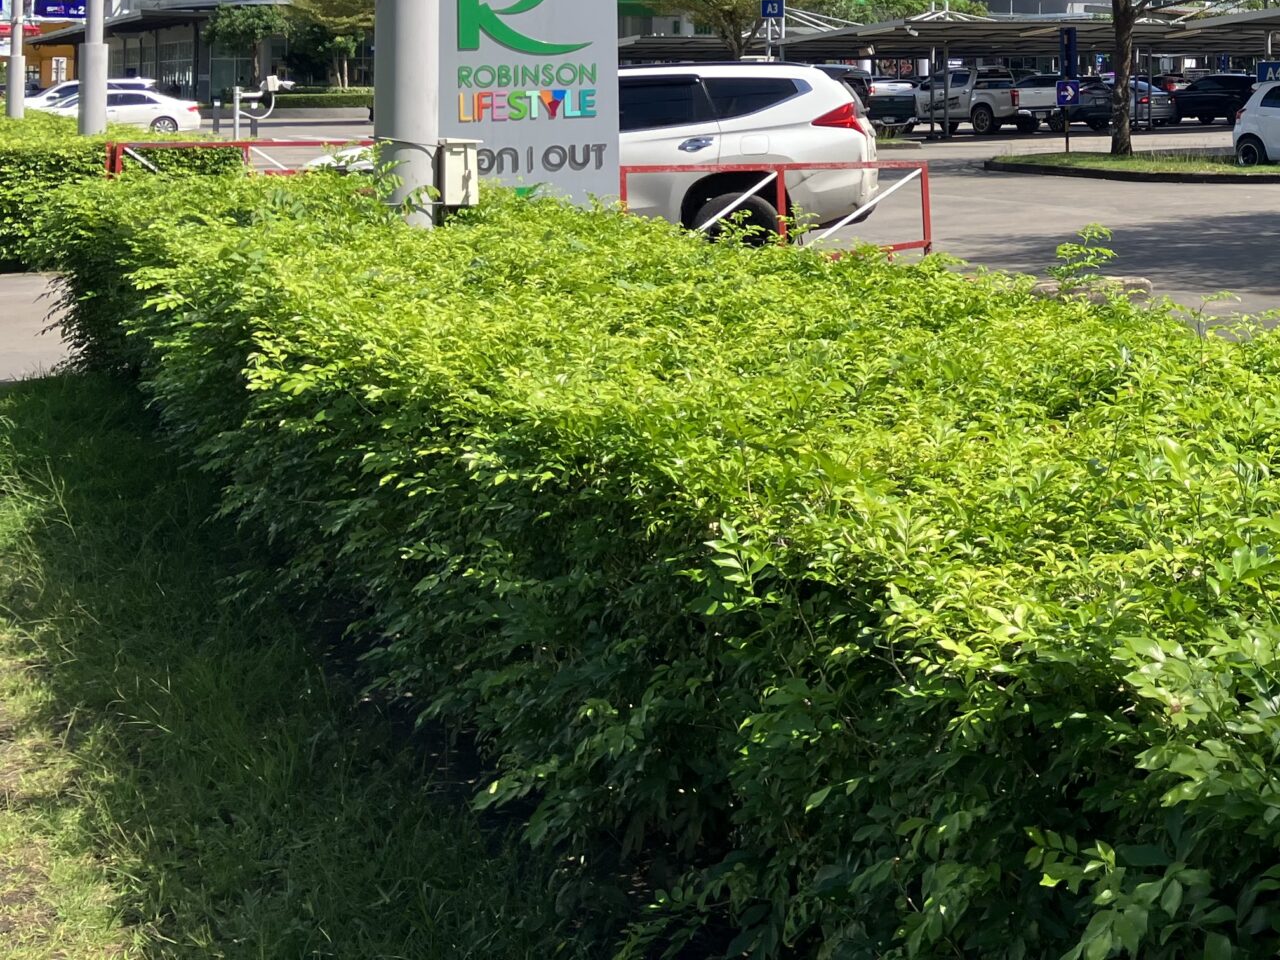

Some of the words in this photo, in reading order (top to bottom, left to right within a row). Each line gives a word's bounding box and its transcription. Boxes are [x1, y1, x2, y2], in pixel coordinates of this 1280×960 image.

[78, 6, 85, 15] 2
[767, 3, 779, 14] A3
[457, 63, 598, 89] ROBINSON
[458, 89, 598, 123] LIFESTYLE
[541, 144, 608, 172] OUT
